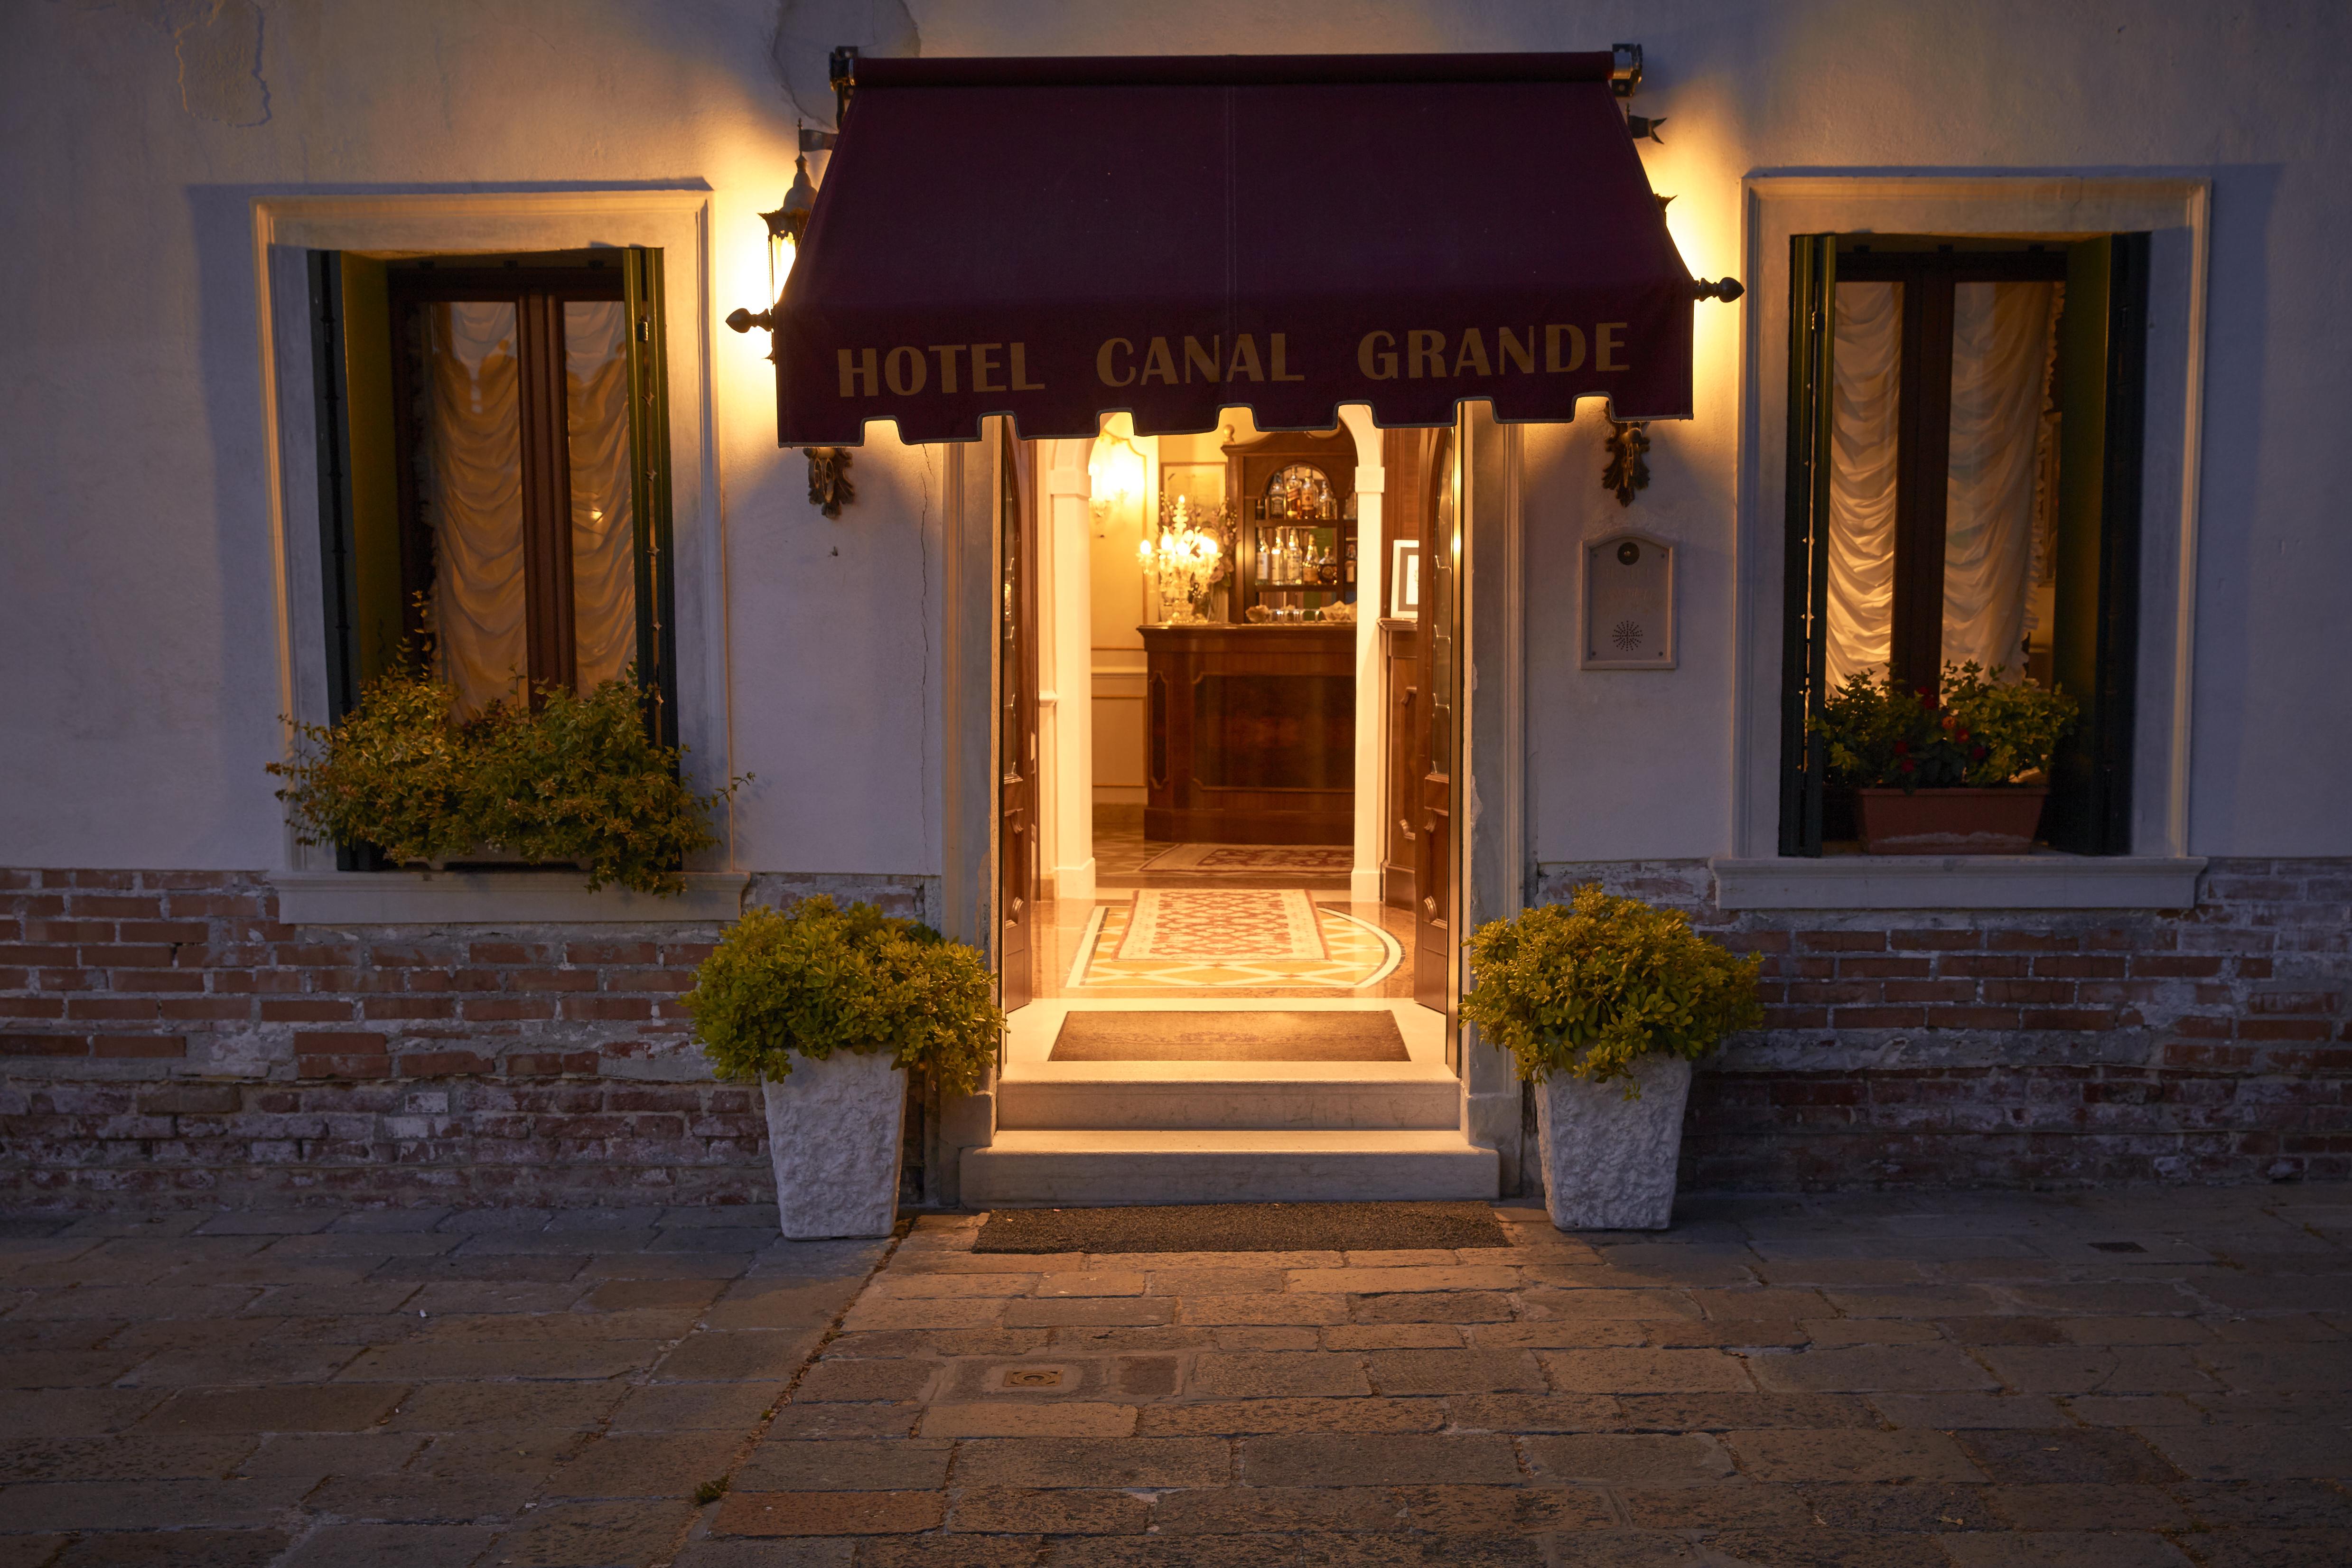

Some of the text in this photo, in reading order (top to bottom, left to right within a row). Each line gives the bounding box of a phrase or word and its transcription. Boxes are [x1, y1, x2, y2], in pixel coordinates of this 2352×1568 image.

[838, 323, 1630, 397] HOTEL CANAL GRANDE
